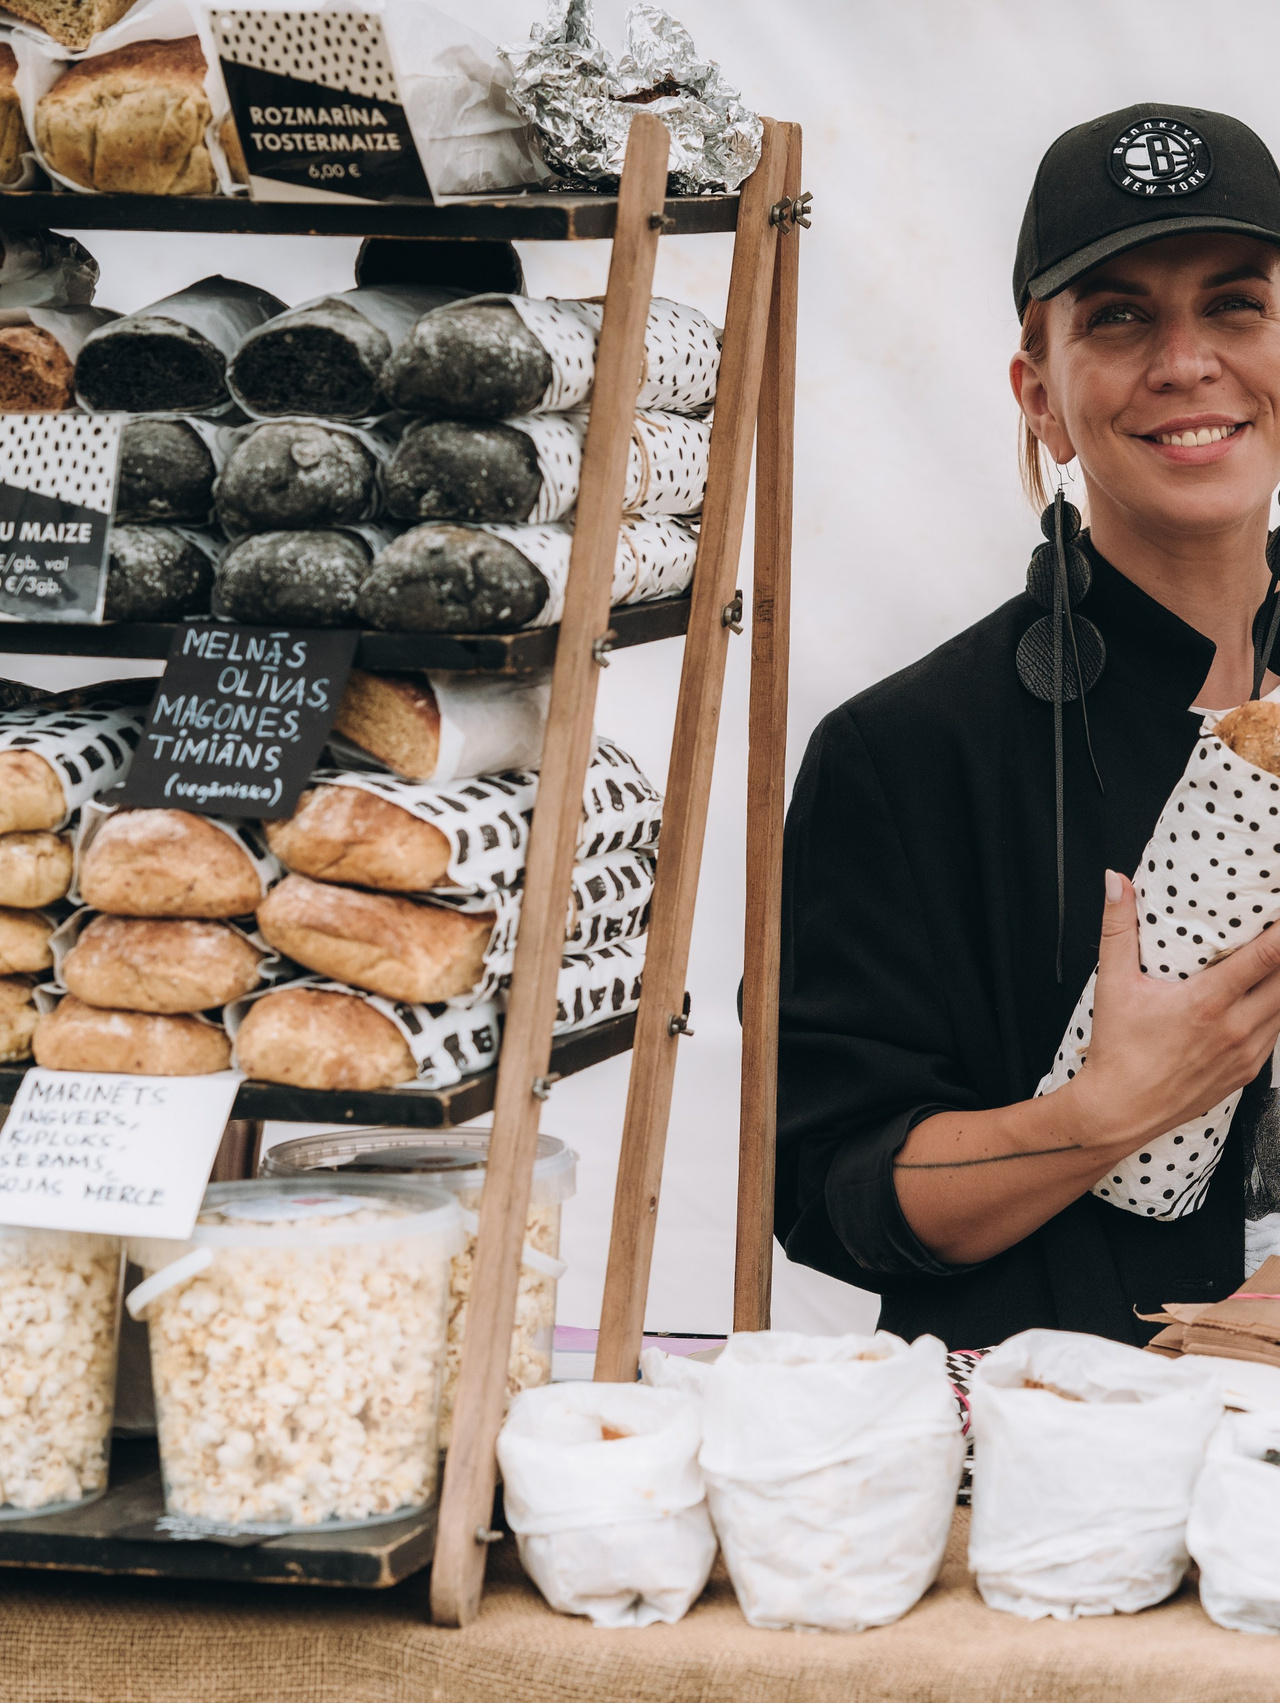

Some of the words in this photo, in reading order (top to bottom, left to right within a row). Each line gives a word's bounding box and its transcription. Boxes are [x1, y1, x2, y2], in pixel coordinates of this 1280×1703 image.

[249, 104, 388, 127] ROZMARĪNA
[251, 132, 402, 152] TOSTERMAIZE
[308, 163, 345, 180] 6,00
[1121, 175, 1158, 195] NEW
[1167, 169, 1206, 194] YORK
[19, 521, 92, 543] MAIZE
